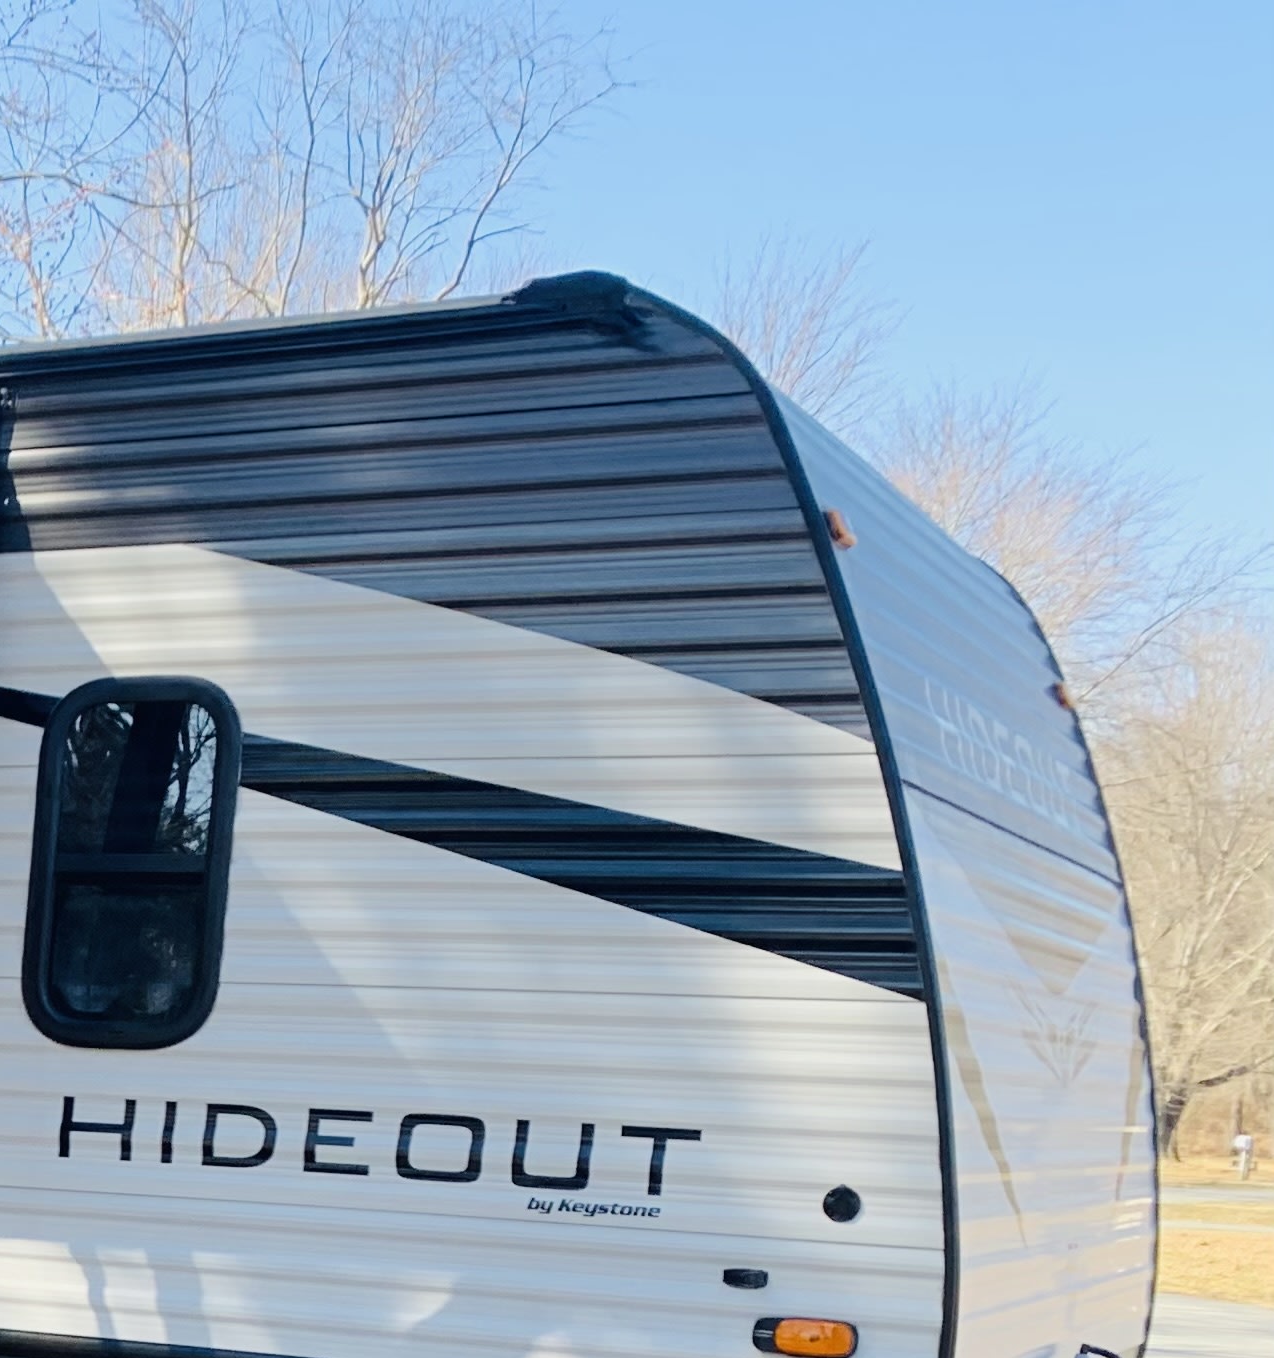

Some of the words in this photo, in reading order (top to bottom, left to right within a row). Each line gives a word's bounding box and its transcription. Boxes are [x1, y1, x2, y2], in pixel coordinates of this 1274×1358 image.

[924, 676, 1081, 836] HIDEOUT
[58, 1095, 703, 1197] HIDEOUT
[527, 1196, 553, 1215] by
[557, 1198, 662, 1220] Keystone
